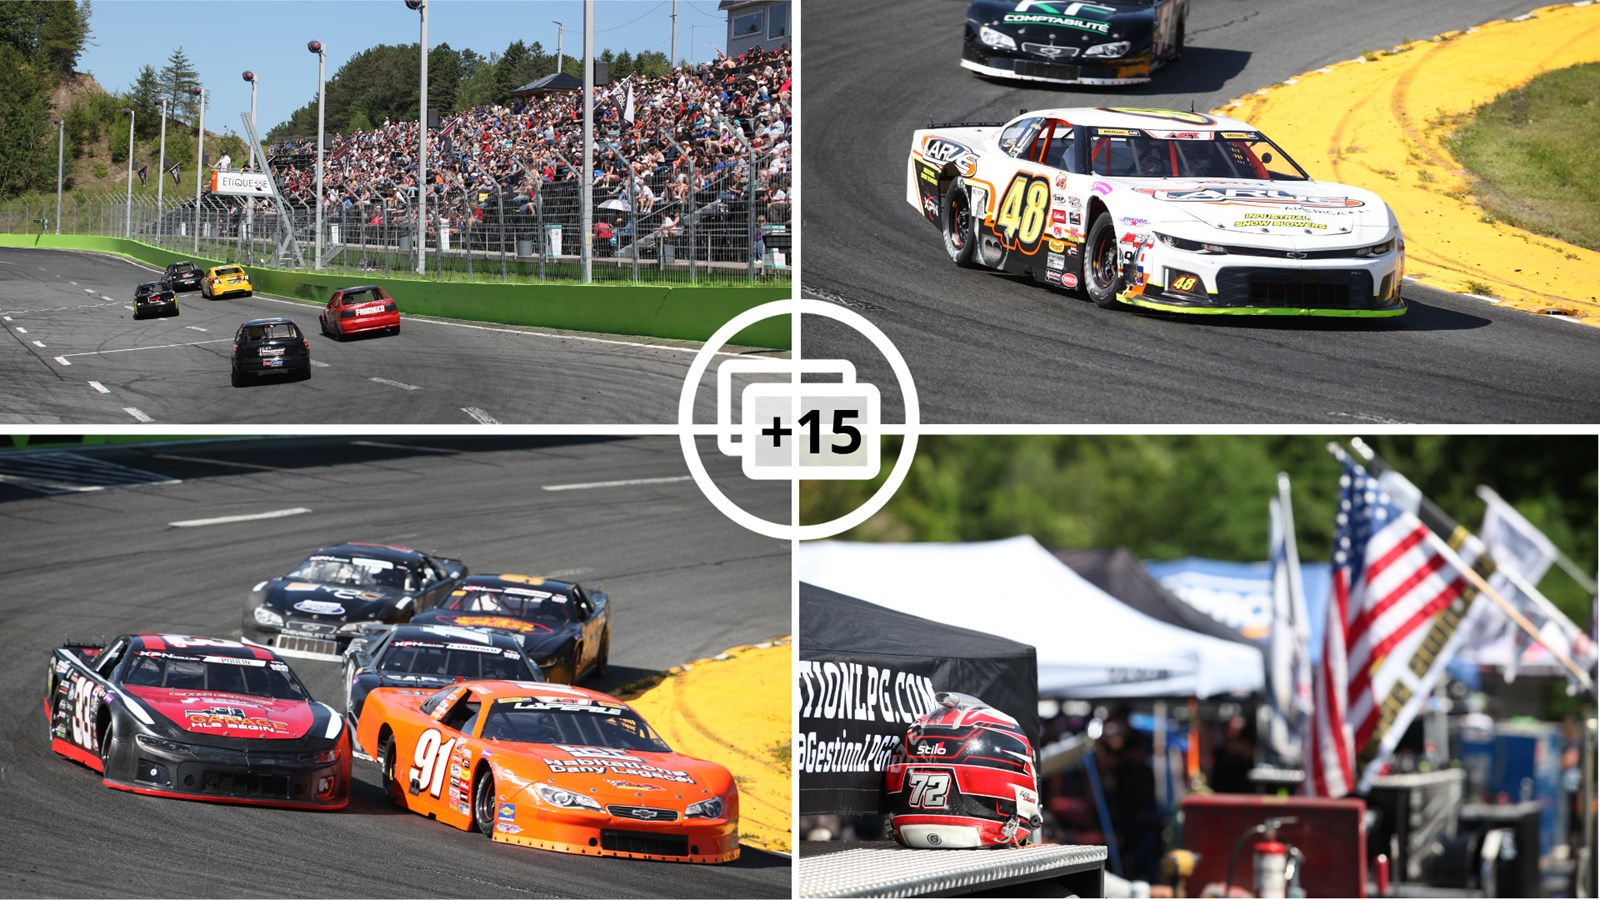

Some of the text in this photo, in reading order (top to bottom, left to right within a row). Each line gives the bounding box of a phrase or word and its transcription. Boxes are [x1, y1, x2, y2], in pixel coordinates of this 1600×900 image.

[1003, 14, 1110, 33] COMPTABILITÉ
[997, 174, 1050, 244] 48
[1243, 213, 1311, 221] INDUSTRIAL
[1233, 220, 1328, 230] SNOW BLOWERS
[1172, 274, 1198, 292] 48
[139, 651, 173, 660] XPN
[799, 660, 940, 723] TIONLPG.COM
[189, 715, 288, 731] GARAGE
[916, 743, 947, 755] Stilo
[409, 728, 457, 799] 91
[543, 758, 689, 777] Habitations
[550, 764, 606, 773] Dany
[909, 773, 951, 808] 72
